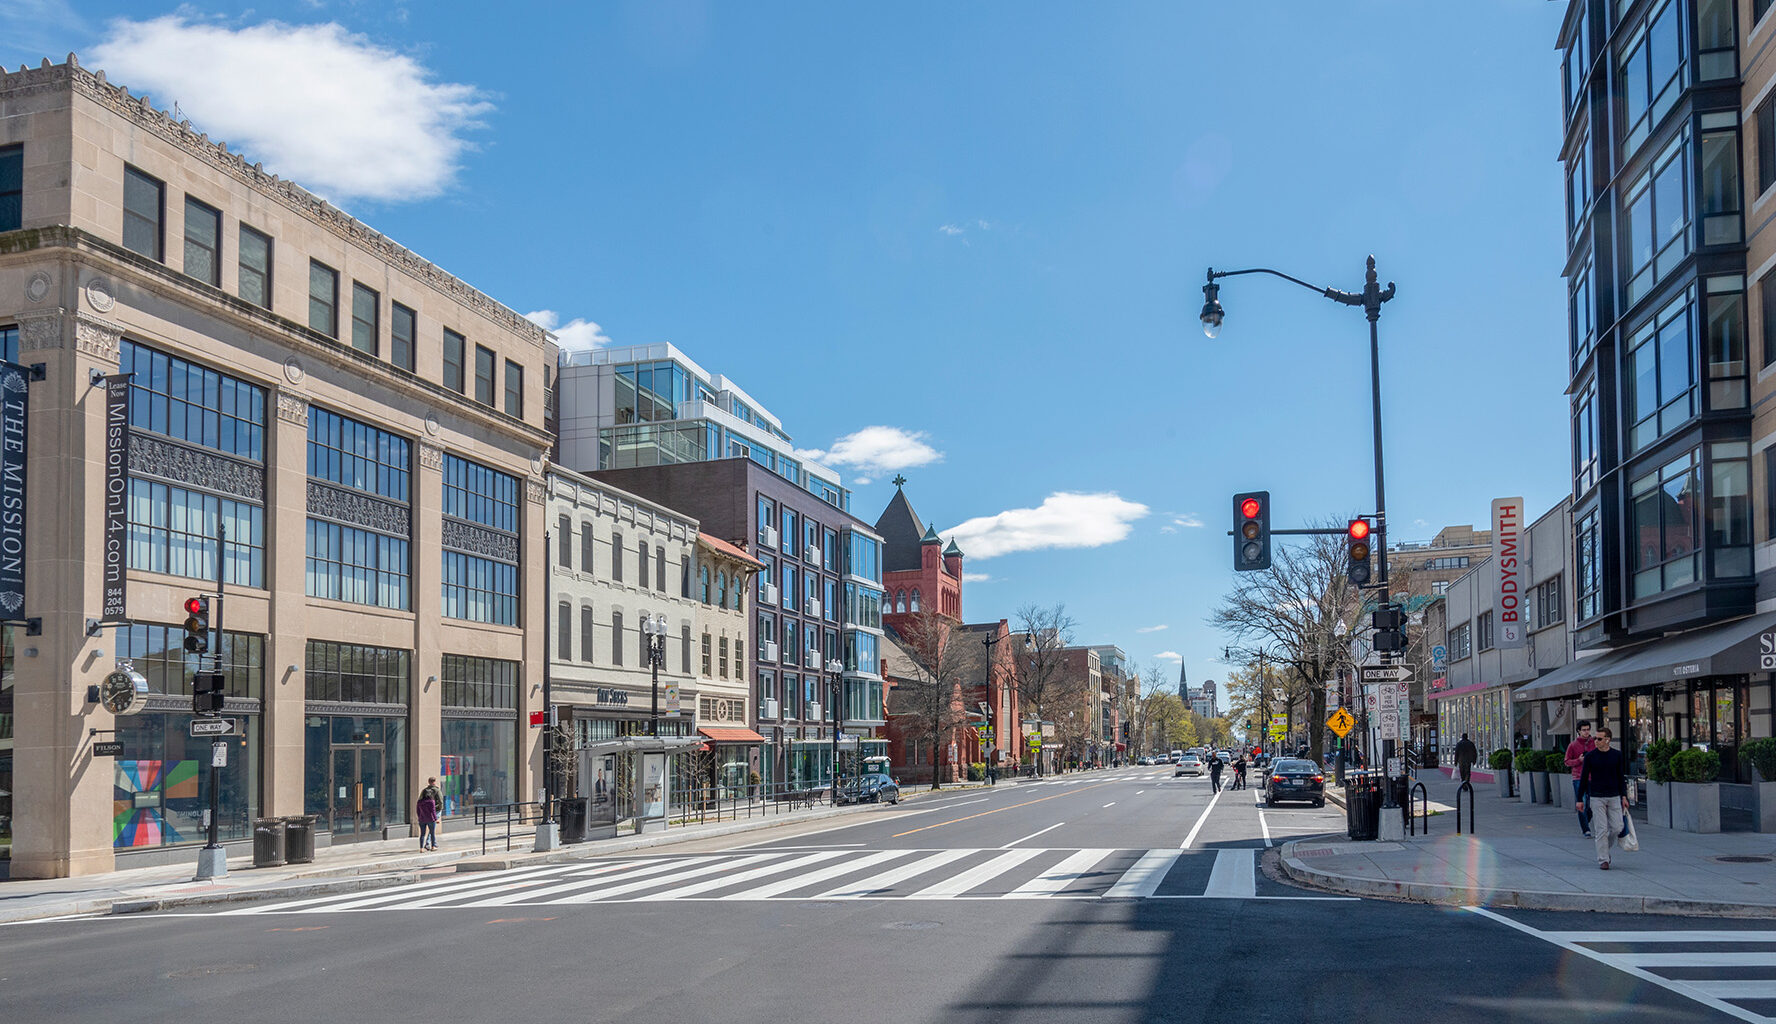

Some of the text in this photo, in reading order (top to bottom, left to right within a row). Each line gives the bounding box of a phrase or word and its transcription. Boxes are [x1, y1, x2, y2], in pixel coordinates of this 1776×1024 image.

[109, 382, 127, 390] Lease
[110, 390, 125, 398] Now
[4, 400, 24, 453] THE
[107, 403, 126, 582] MissionOn14.com
[2, 460, 23, 574] MISSION
[1499, 505, 1518, 622] BODYSMITH
[107, 588, 122, 597] 844
[107, 598, 122, 606] 204
[104, 606, 124, 616] 0579
[1762, 656, 1776, 668] O
